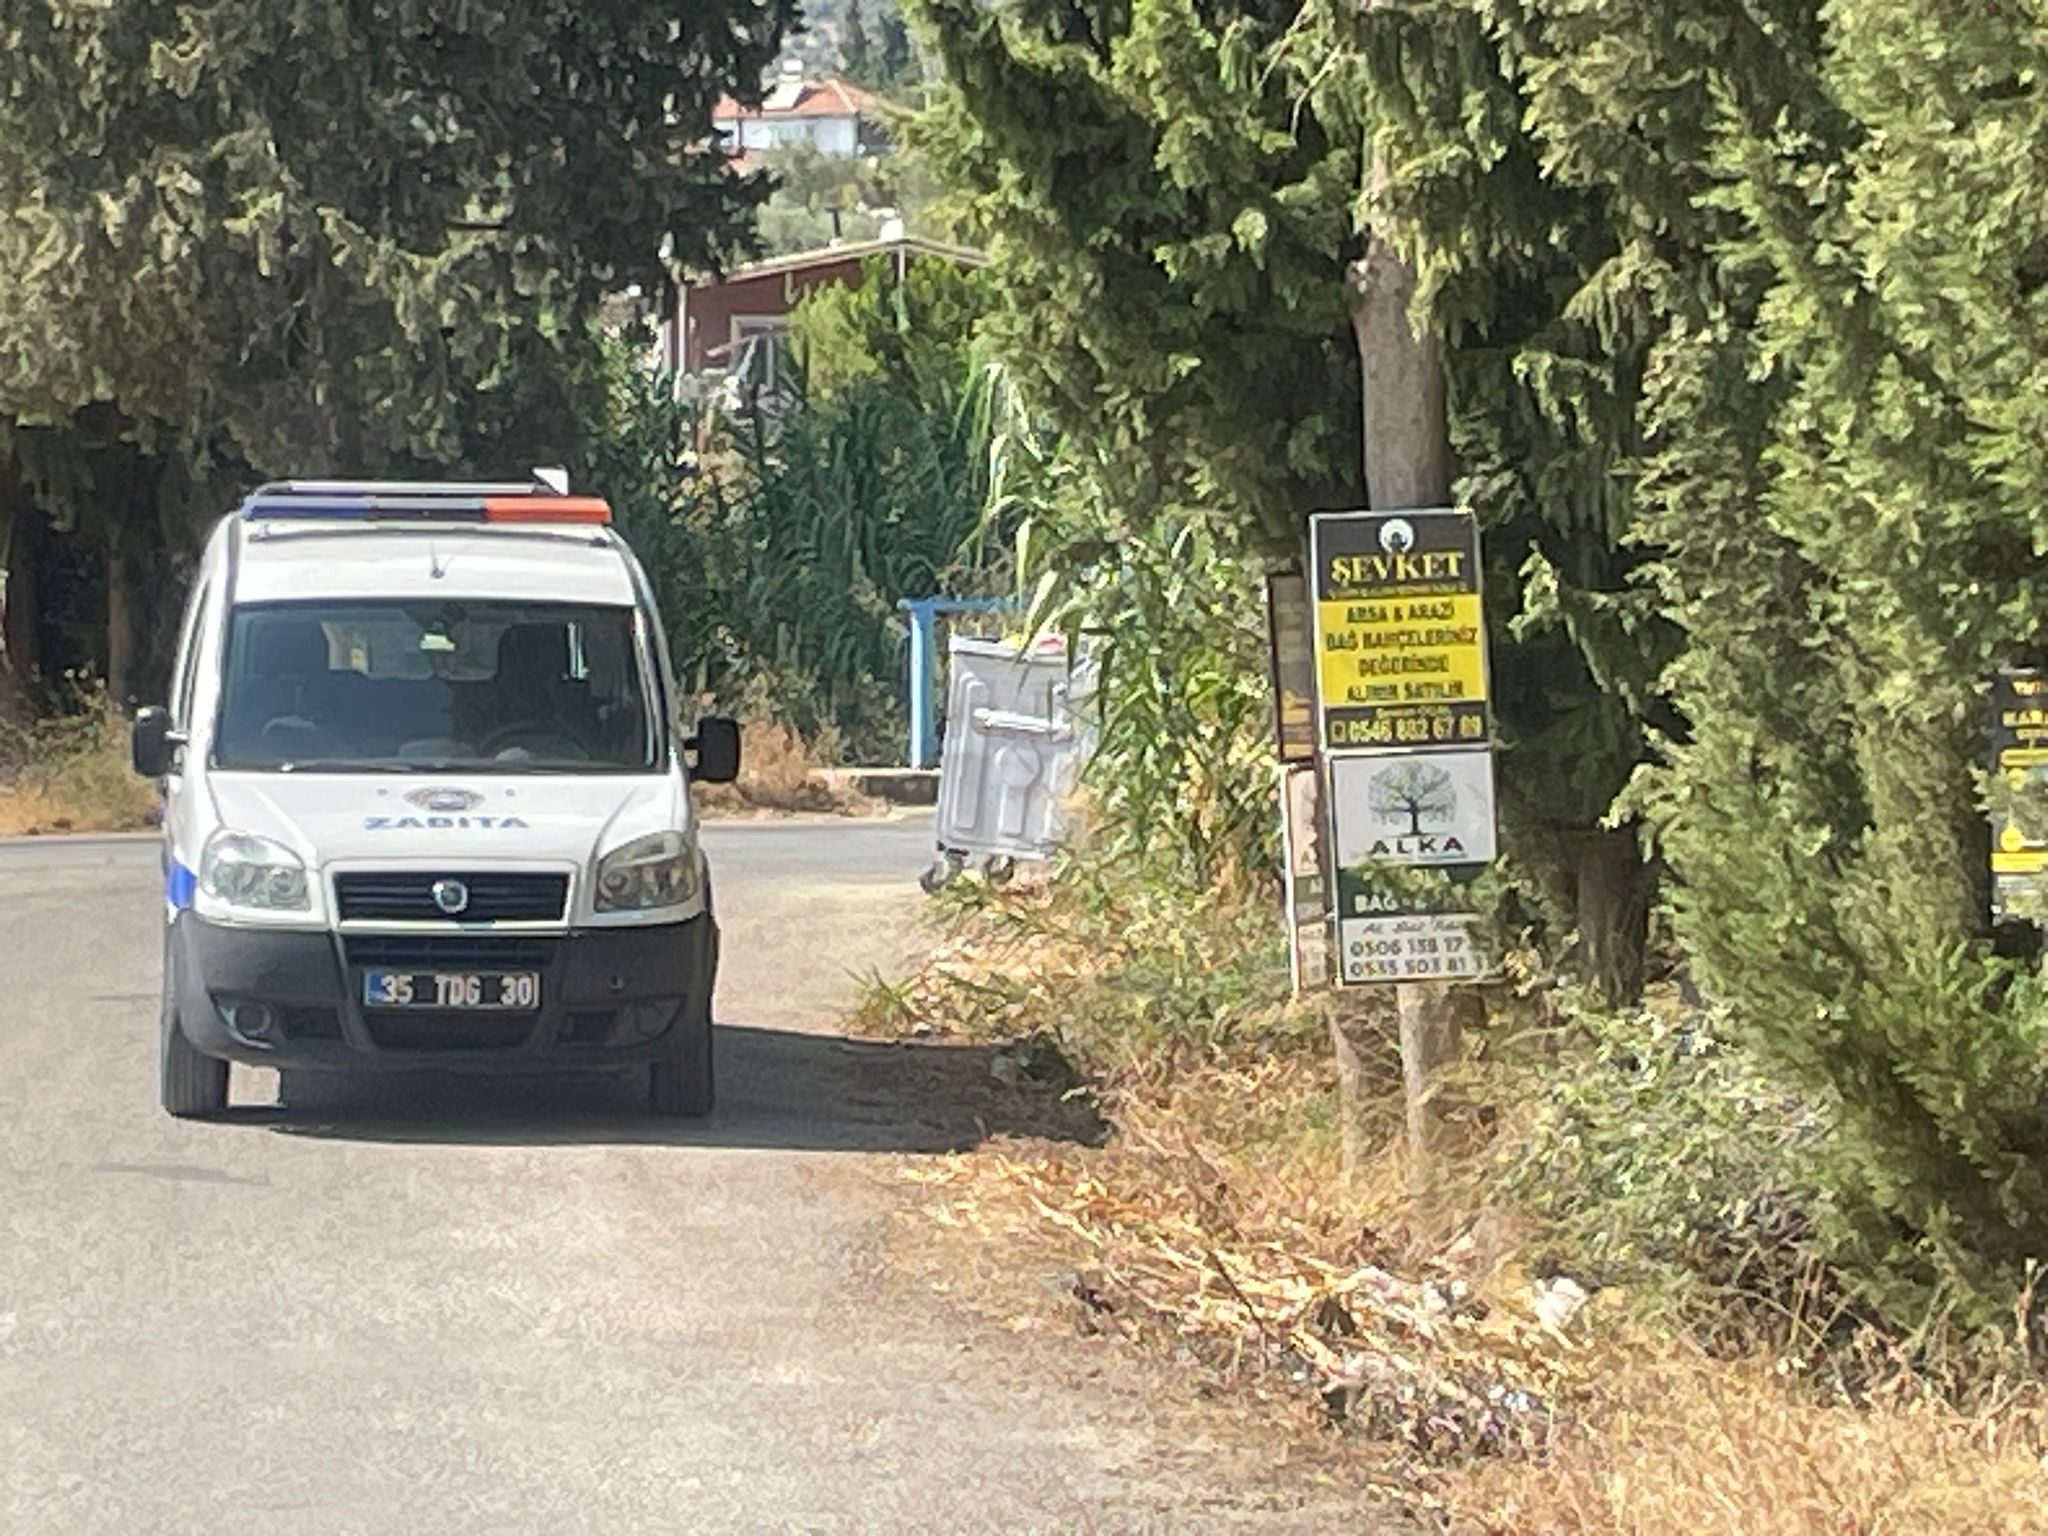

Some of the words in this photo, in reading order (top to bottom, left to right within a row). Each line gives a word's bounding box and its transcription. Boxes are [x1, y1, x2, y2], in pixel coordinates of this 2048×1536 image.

[1331, 552, 1465, 587] ŞEVKET
[1347, 606, 1387, 623] ARSA
[1408, 601, 1455, 621] ARAZİ
[1358, 654, 1449, 677] DEĞERİNDE
[1370, 837, 1464, 854] ALKA
[381, 975, 414, 1003] 35
[434, 974, 481, 1004] TDG
[501, 975, 533, 1004] 30
